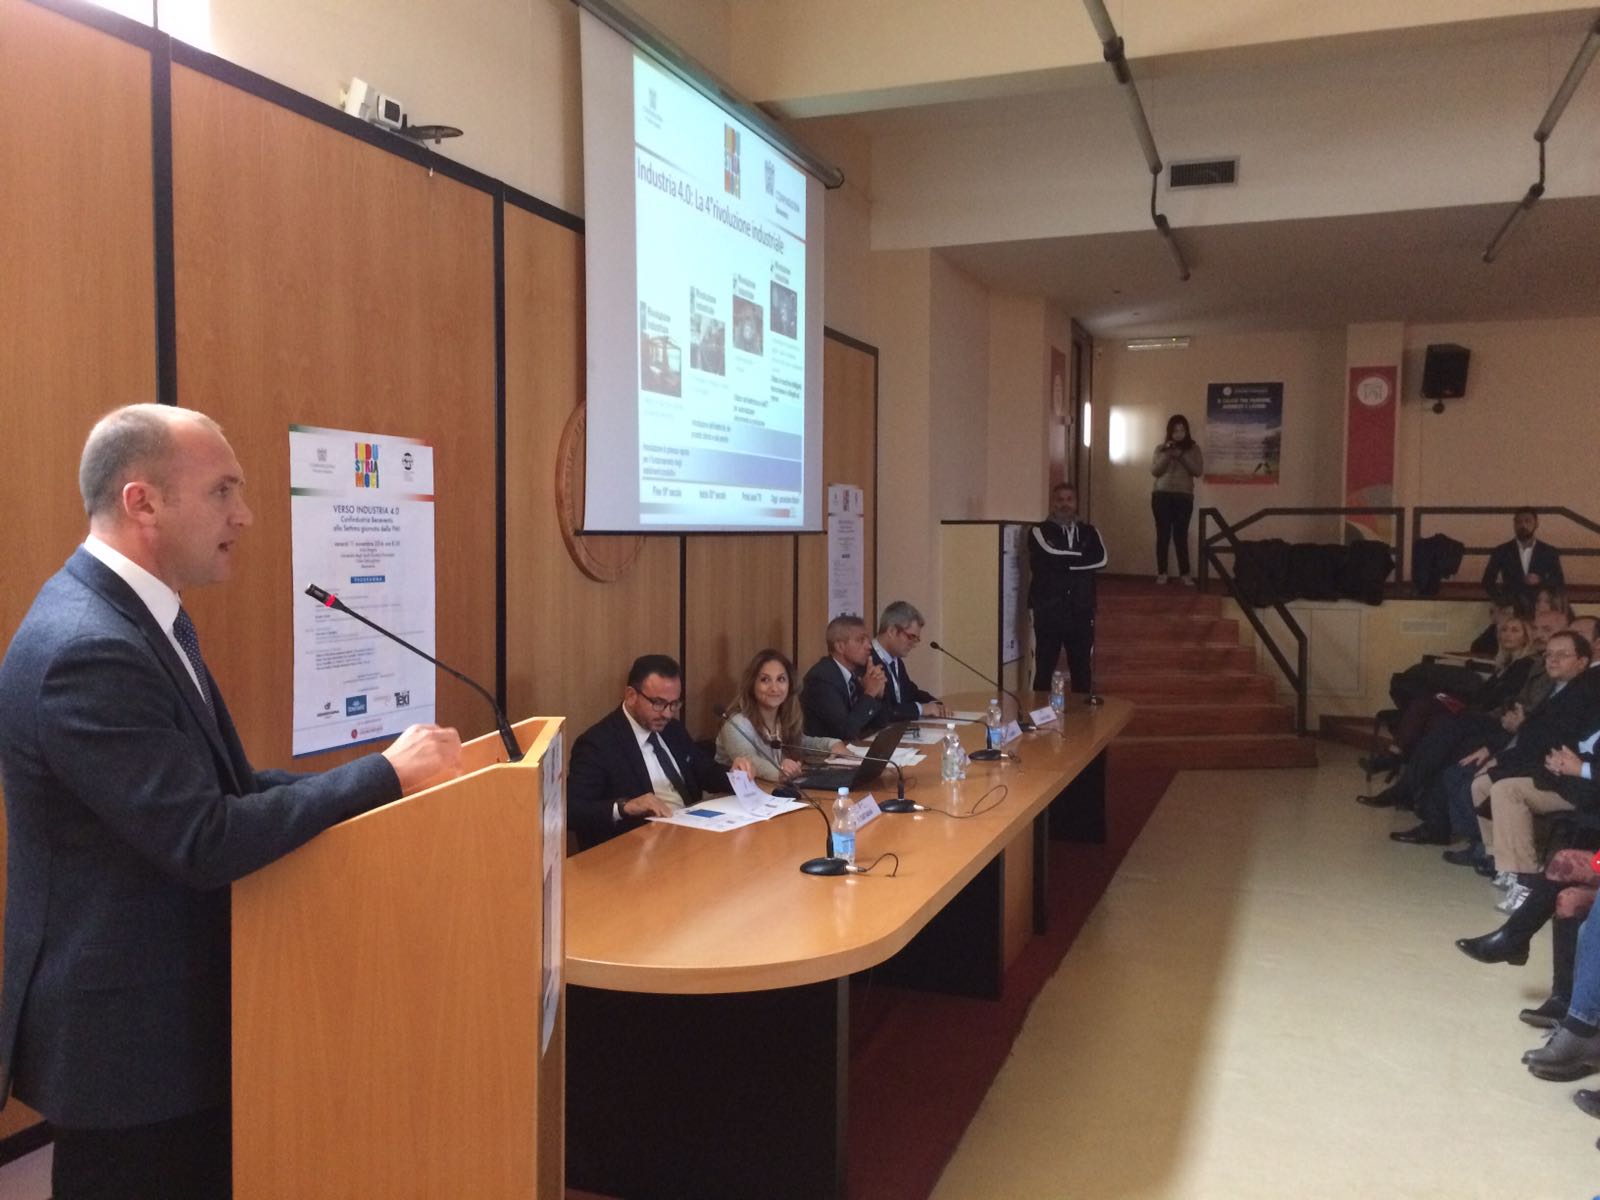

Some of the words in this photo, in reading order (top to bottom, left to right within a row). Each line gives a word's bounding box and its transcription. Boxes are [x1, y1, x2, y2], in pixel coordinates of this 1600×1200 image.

[637, 157, 676, 197] Industria
[695, 188, 704, 212] La
[713, 200, 751, 238] rivoluzione
[751, 219, 784, 255] industriale
[333, 504, 355, 514] VERSO
[356, 505, 389, 515] INDUSTRIA
